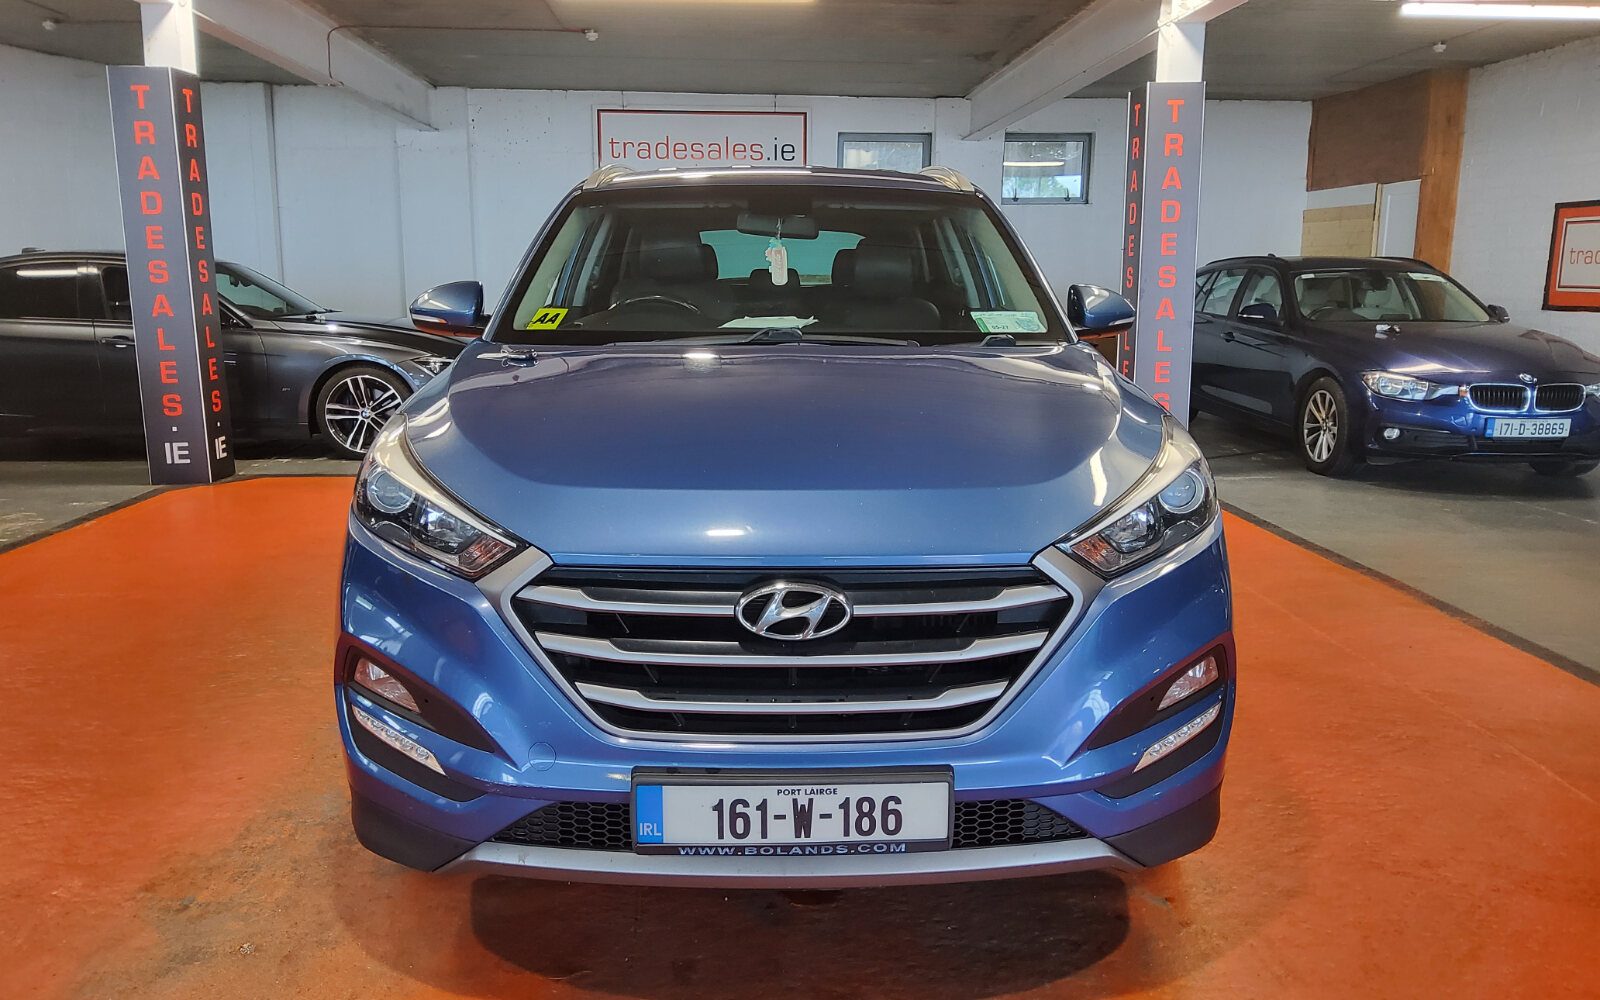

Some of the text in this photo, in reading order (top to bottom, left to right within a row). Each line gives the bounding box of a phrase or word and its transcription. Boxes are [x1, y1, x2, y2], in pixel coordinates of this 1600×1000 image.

[609, 136, 796, 161] tradesales.ie
[533, 313, 561, 324] AA
[1500, 423, 1564, 436] 171-D-38869
[777, 787, 838, 796] PORT LÁIRGE
[712, 795, 903, 840] 161-W-186
[639, 822, 662, 836] IRL
[679, 843, 906, 855] WWW.BOLANDS.COM
